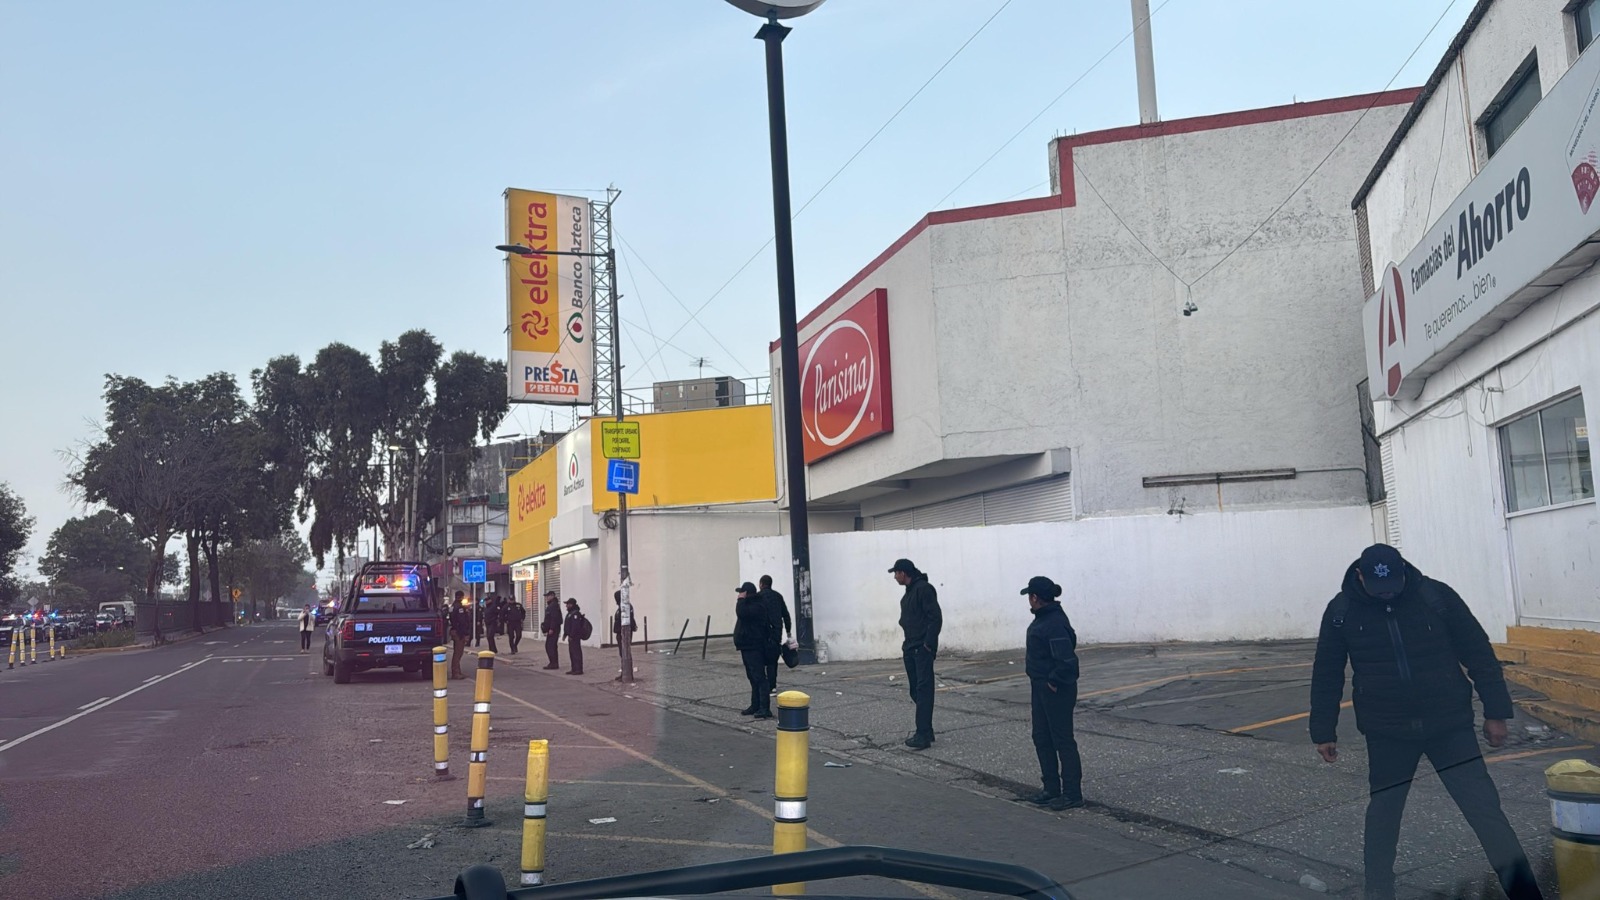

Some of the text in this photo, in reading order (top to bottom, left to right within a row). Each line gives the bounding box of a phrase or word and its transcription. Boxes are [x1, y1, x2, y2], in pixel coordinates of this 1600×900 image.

[1411, 166, 1531, 295] Farmacias del Ahorro
[521, 202, 549, 305] elektra
[571, 206, 583, 309] Banco Azteca
[1424, 321, 1432, 341] Te
[1432, 297, 1473, 339] queremos...
[529, 383, 575, 394] PRENDA
[814, 352, 869, 414] Parisina
[525, 480, 546, 513] elektra
[563, 478, 585, 496] Banco Azteca
[369, 636, 394, 644] POLICÍA
